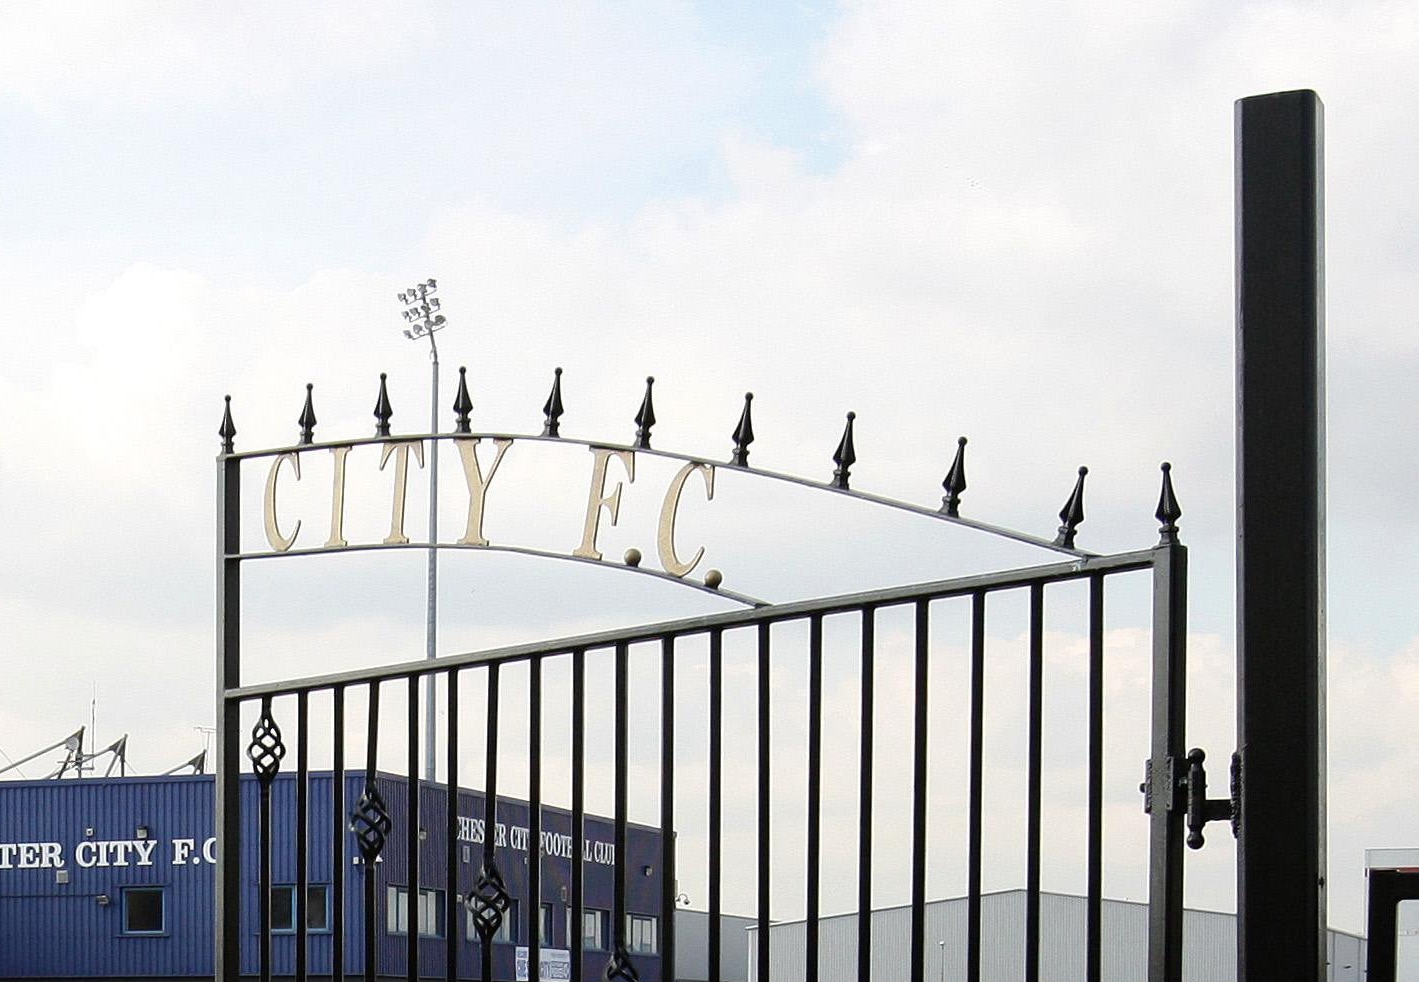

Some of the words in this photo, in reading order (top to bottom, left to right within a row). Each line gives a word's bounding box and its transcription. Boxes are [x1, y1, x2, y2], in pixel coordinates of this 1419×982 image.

[263, 438, 515, 552] CITY
[573, 444, 723, 588] F.C.
[457, 815, 507, 848] CHESER
[510, 825, 530, 851] CIT
[75, 839, 157, 868] CITY
